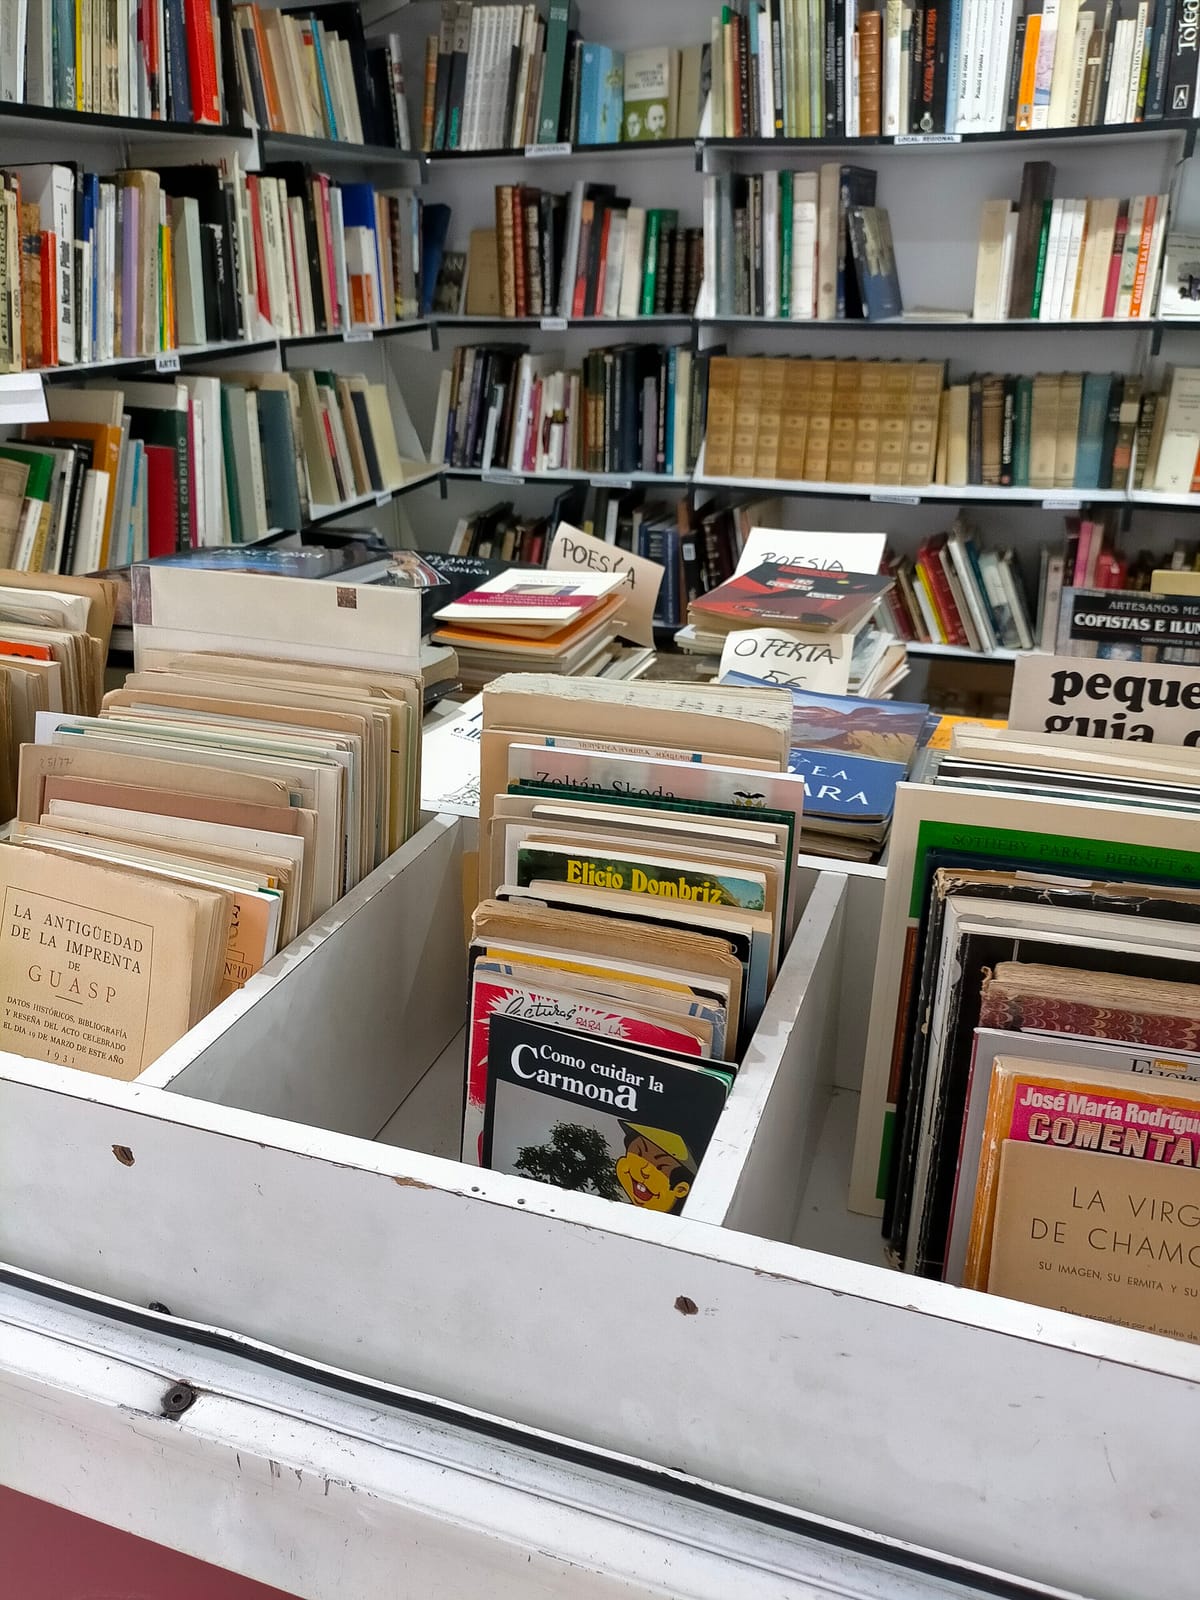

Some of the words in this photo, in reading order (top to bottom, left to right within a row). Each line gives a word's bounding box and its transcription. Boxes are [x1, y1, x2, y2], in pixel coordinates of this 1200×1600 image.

[158, 359, 178, 369] ARTE
[1074, 613, 1151, 631] COPISTAS
[1154, 619, 1167, 632] E
[1109, 601, 1178, 614] ARTESANOS
[734, 638, 841, 665] OFERTA
[952, 834, 1030, 852] SOTHEBY
[1040, 844, 1097, 863] PARKE
[1105, 852, 1178, 871] BERNET
[566, 859, 624, 889] Elicio
[631, 868, 722, 905] Dombriz
[11, 924, 31, 941] DE
[39, 931, 57, 948] LA
[66, 939, 141, 974] IMPRENTA
[14, 904, 32, 920] LA
[43, 913, 143, 953] ANTIGÜEDAD
[28, 964, 116, 1004] GUASP
[68, 960, 81, 972] DE
[5, 1008, 11, 1016] Y
[13, 1010, 41, 1026] RESEÑA
[43, 1020, 58, 1031] DEL
[61, 1026, 80, 1038] ACTO
[82, 1032, 126, 1052] CELEBRADO
[7, 996, 31, 1009] DATOS
[33, 1003, 76, 1023] HISTÓRICOS,
[78, 1017, 128, 1039] BIBLIOGRAFÍA
[575, 1017, 601, 1031] PARA
[608, 1025, 622, 1036] LA
[3, 1021, 12, 1030] EL
[38, 1032, 48, 1041] DE
[50, 1036, 75, 1049] MARZO
[76, 1044, 87, 1053] DE
[88, 1047, 107, 1060] ESTE
[107, 1053, 124, 1065] AÑO
[511, 1043, 638, 1112] Carmona
[540, 1044, 586, 1071] Como
[590, 1063, 645, 1088] cuidar
[648, 1075, 665, 1094] la
[1020, 1087, 1065, 1111] José
[1067, 1093, 1122, 1121] María
[1125, 1103, 1200, 1135] Rodrígu
[1027, 1112, 1200, 1168] COMENTA
[1072, 1186, 1106, 1213] LA
[1128, 1195, 1200, 1228] VIRG
[1031, 1217, 1067, 1244] DE
[1039, 1261, 1052, 1271] SU
[1058, 1264, 1102, 1281] IMAGEN,
[1107, 1272, 1121, 1283] SU
[1127, 1276, 1164, 1292] ERMITA
[1170, 1285, 1177, 1293] Y
[1184, 1287, 1198, 1298] SU
[1147, 1324, 1156, 1332] el
[1158, 1328, 1184, 1338] centro
[1187, 1331, 1198, 1340] de
